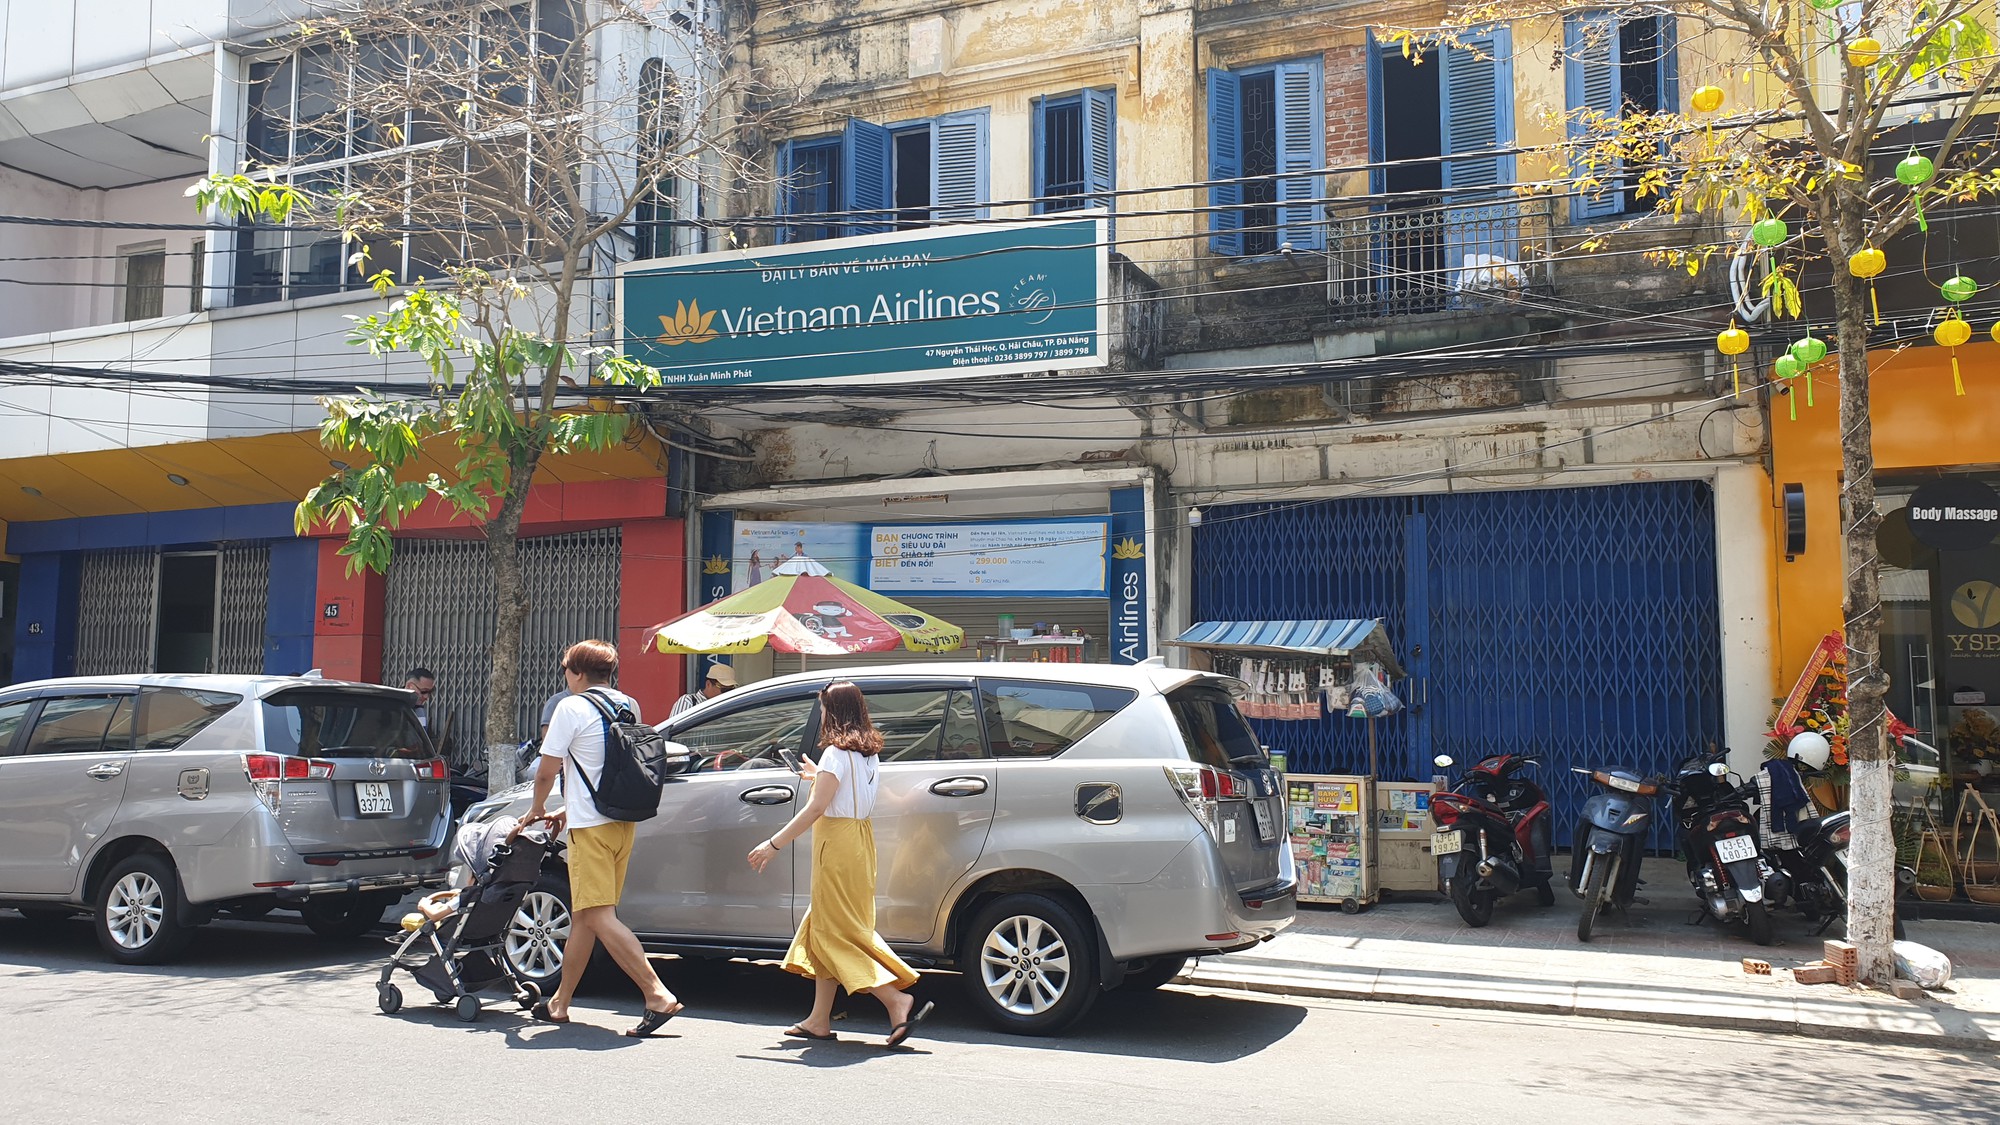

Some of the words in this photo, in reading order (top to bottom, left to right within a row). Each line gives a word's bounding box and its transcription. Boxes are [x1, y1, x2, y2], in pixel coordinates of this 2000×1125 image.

[761, 268, 786, 285] ĐẠI
[789, 263, 805, 280] LÝ
[809, 261, 839, 278] BÁN
[866, 255, 898, 273] MÁY
[902, 252, 932, 269] BAY
[721, 304, 861, 339] Vietnam
[866, 288, 1001, 328] Airlines
[925, 349, 935, 357] 47
[965, 345, 981, 354] Thái
[982, 343, 998, 355] Học,
[999, 343, 1008, 352] Q.
[1008, 340, 1021, 350] Hải
[1022, 339, 1043, 349] Châu,
[1044, 338, 1056, 347] TP.
[1056, 335, 1068, 346] Đà
[952, 356, 970, 366] Điện
[994, 353, 1013, 363] 0236
[1014, 352, 1033, 361] 3899
[1034, 350, 1048, 360] 797
[1054, 348, 1073, 357] 3899
[1074, 346, 1089, 356] 798
[662, 375, 686, 384] TNHH
[687, 372, 709, 383] Xuân
[710, 370, 731, 380] Minh
[733, 369, 753, 379] Phát
[1912, 506, 1942, 522] Body
[1944, 506, 1999, 522] Massage
[876, 533, 898, 545] BẠN
[901, 532, 933, 540] CHƯƠNG
[935, 531, 959, 540] TRÌNH
[883, 543, 899, 555] CÓ
[901, 540, 918, 549] SIÊU
[975, 557, 1008, 565] 299.000
[325, 605, 338, 617] 45
[1118, 571, 1139, 662] Airlines
[1947, 633, 2000, 651] YSP
[365, 783, 384, 798] 43A
[360, 798, 393, 812] 337.22
[1435, 832, 1457, 844] 43-C1
[1722, 837, 1748, 851] 43-E1
[1433, 841, 1460, 854] 199.25
[1722, 846, 1754, 861] 480.37
